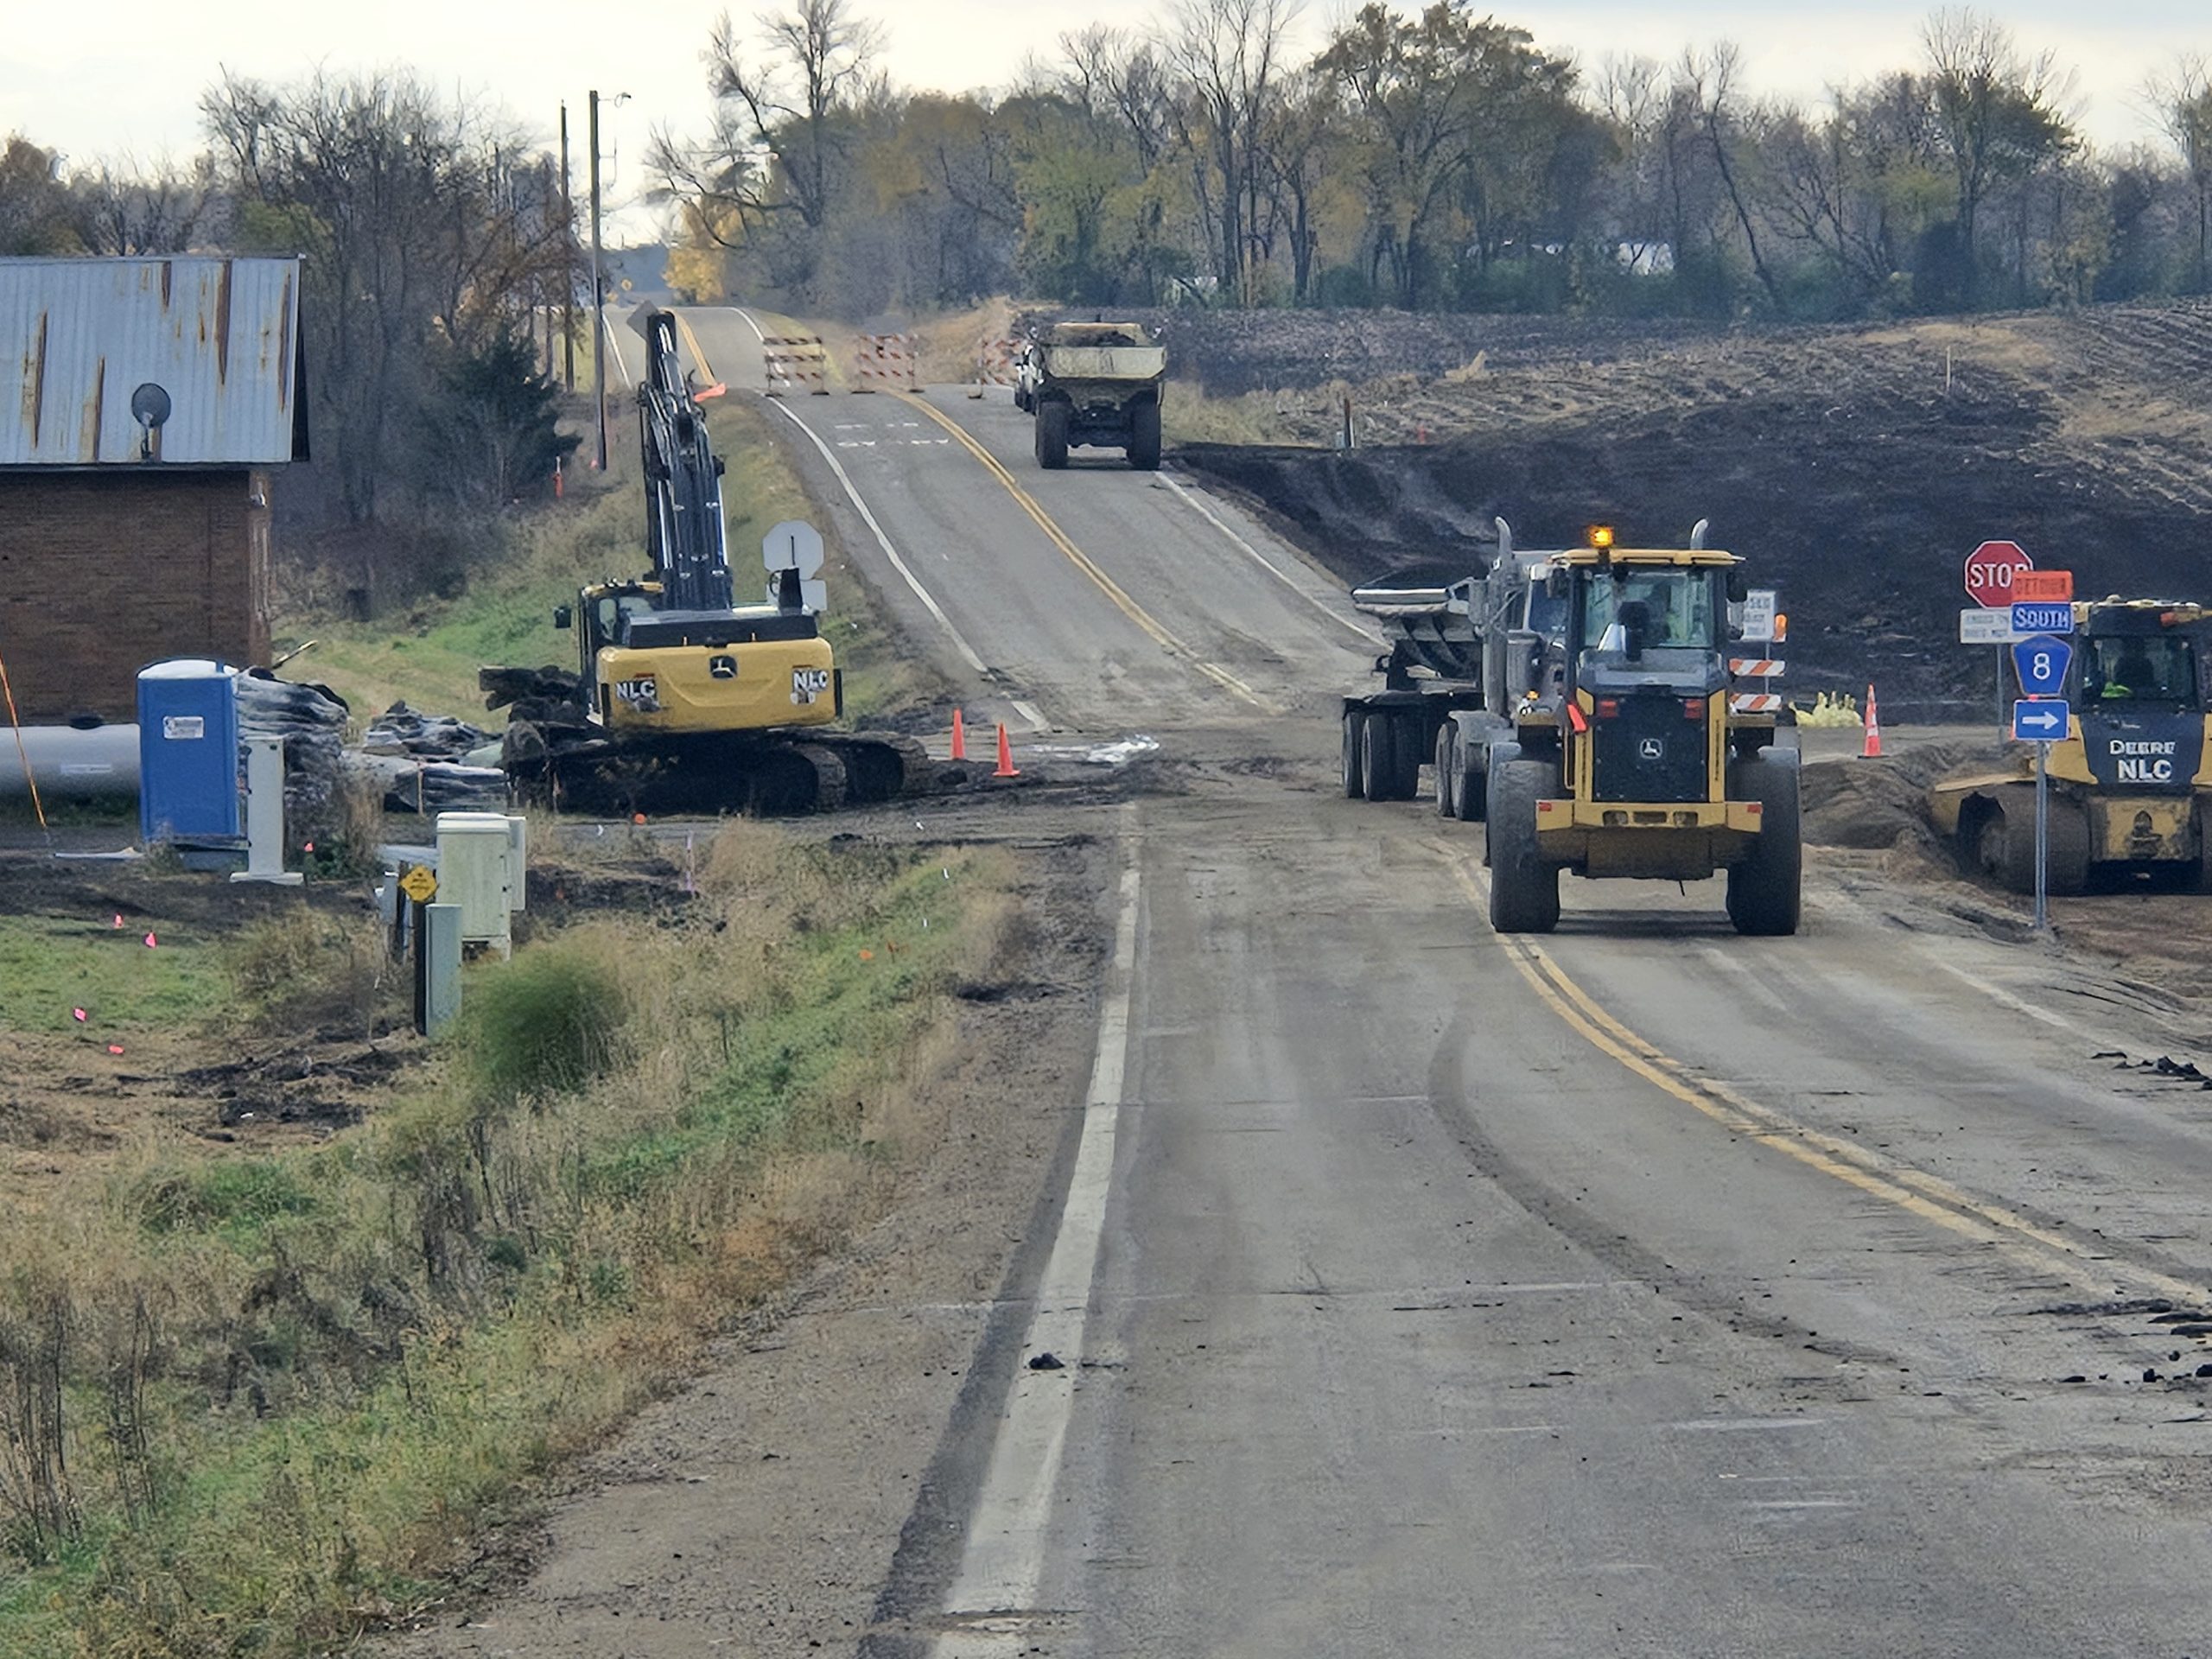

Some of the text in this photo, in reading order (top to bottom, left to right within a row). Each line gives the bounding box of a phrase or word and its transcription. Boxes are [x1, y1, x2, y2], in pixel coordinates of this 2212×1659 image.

[2016, 607, 2069, 629] SOUTH
[2033, 652, 2050, 680] 8
[616, 681, 655, 699] NLC
[794, 671, 827, 690] NLC
[2110, 741, 2176, 754] DEERE
[2118, 760, 2171, 779] NLC
